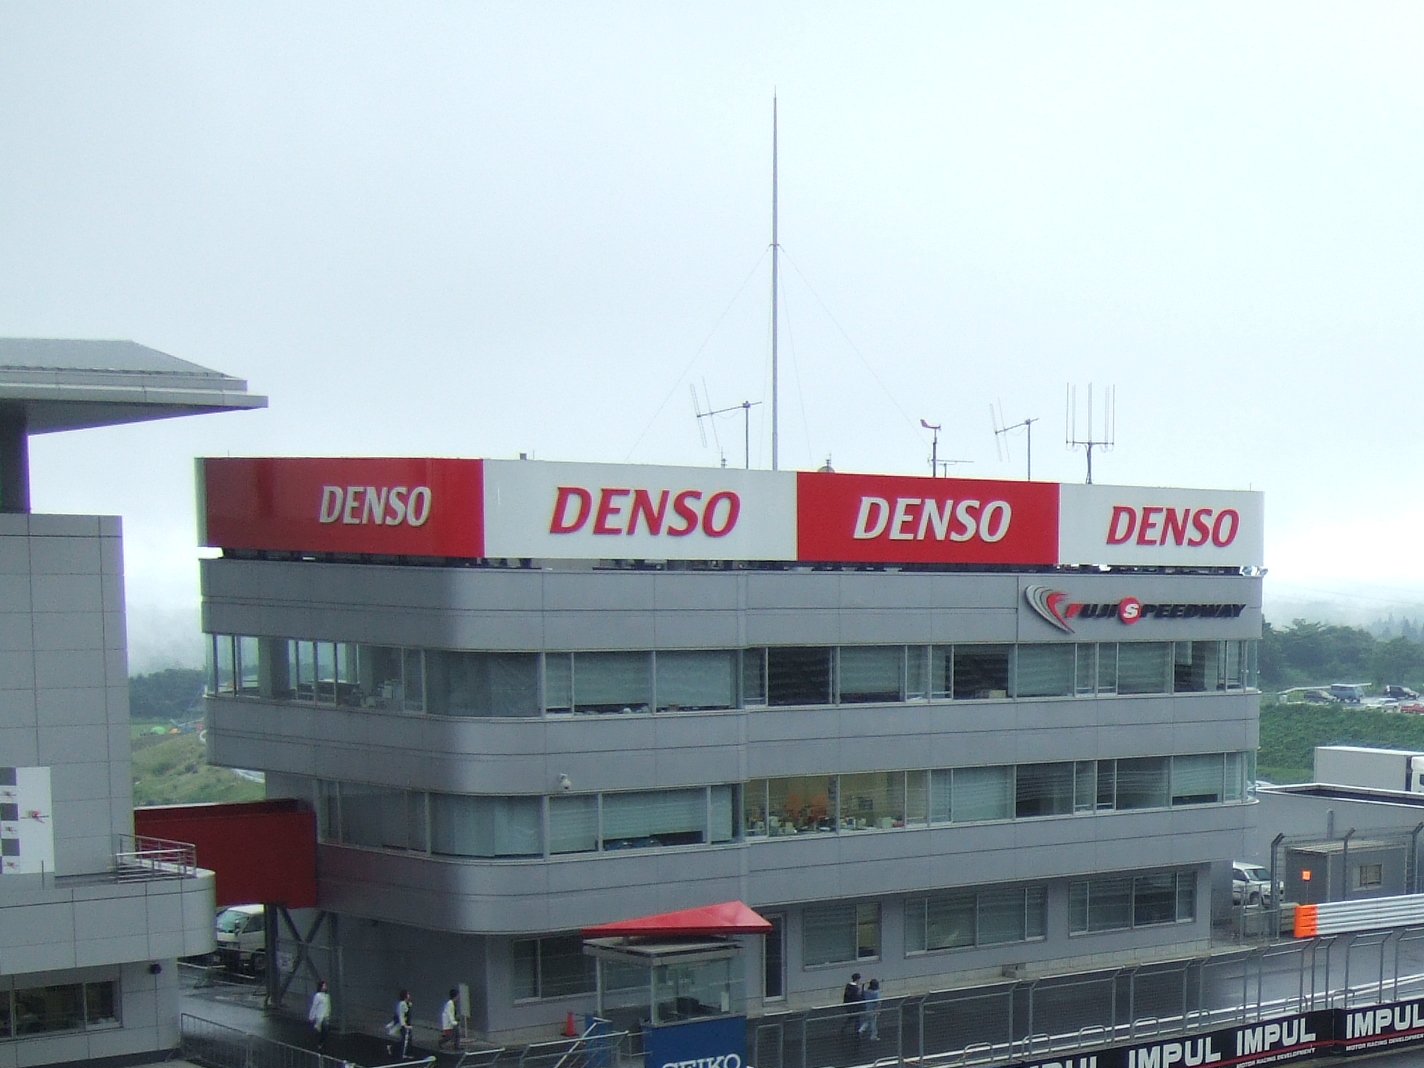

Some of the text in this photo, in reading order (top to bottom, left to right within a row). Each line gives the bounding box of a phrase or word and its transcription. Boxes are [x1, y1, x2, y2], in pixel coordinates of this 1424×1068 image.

[319, 485, 432, 527] DENSO
[549, 486, 741, 538] DENSO
[853, 496, 1012, 542] DENSO
[1106, 505, 1240, 548] DENSO
[1236, 1018, 1317, 1057] IMPUL
